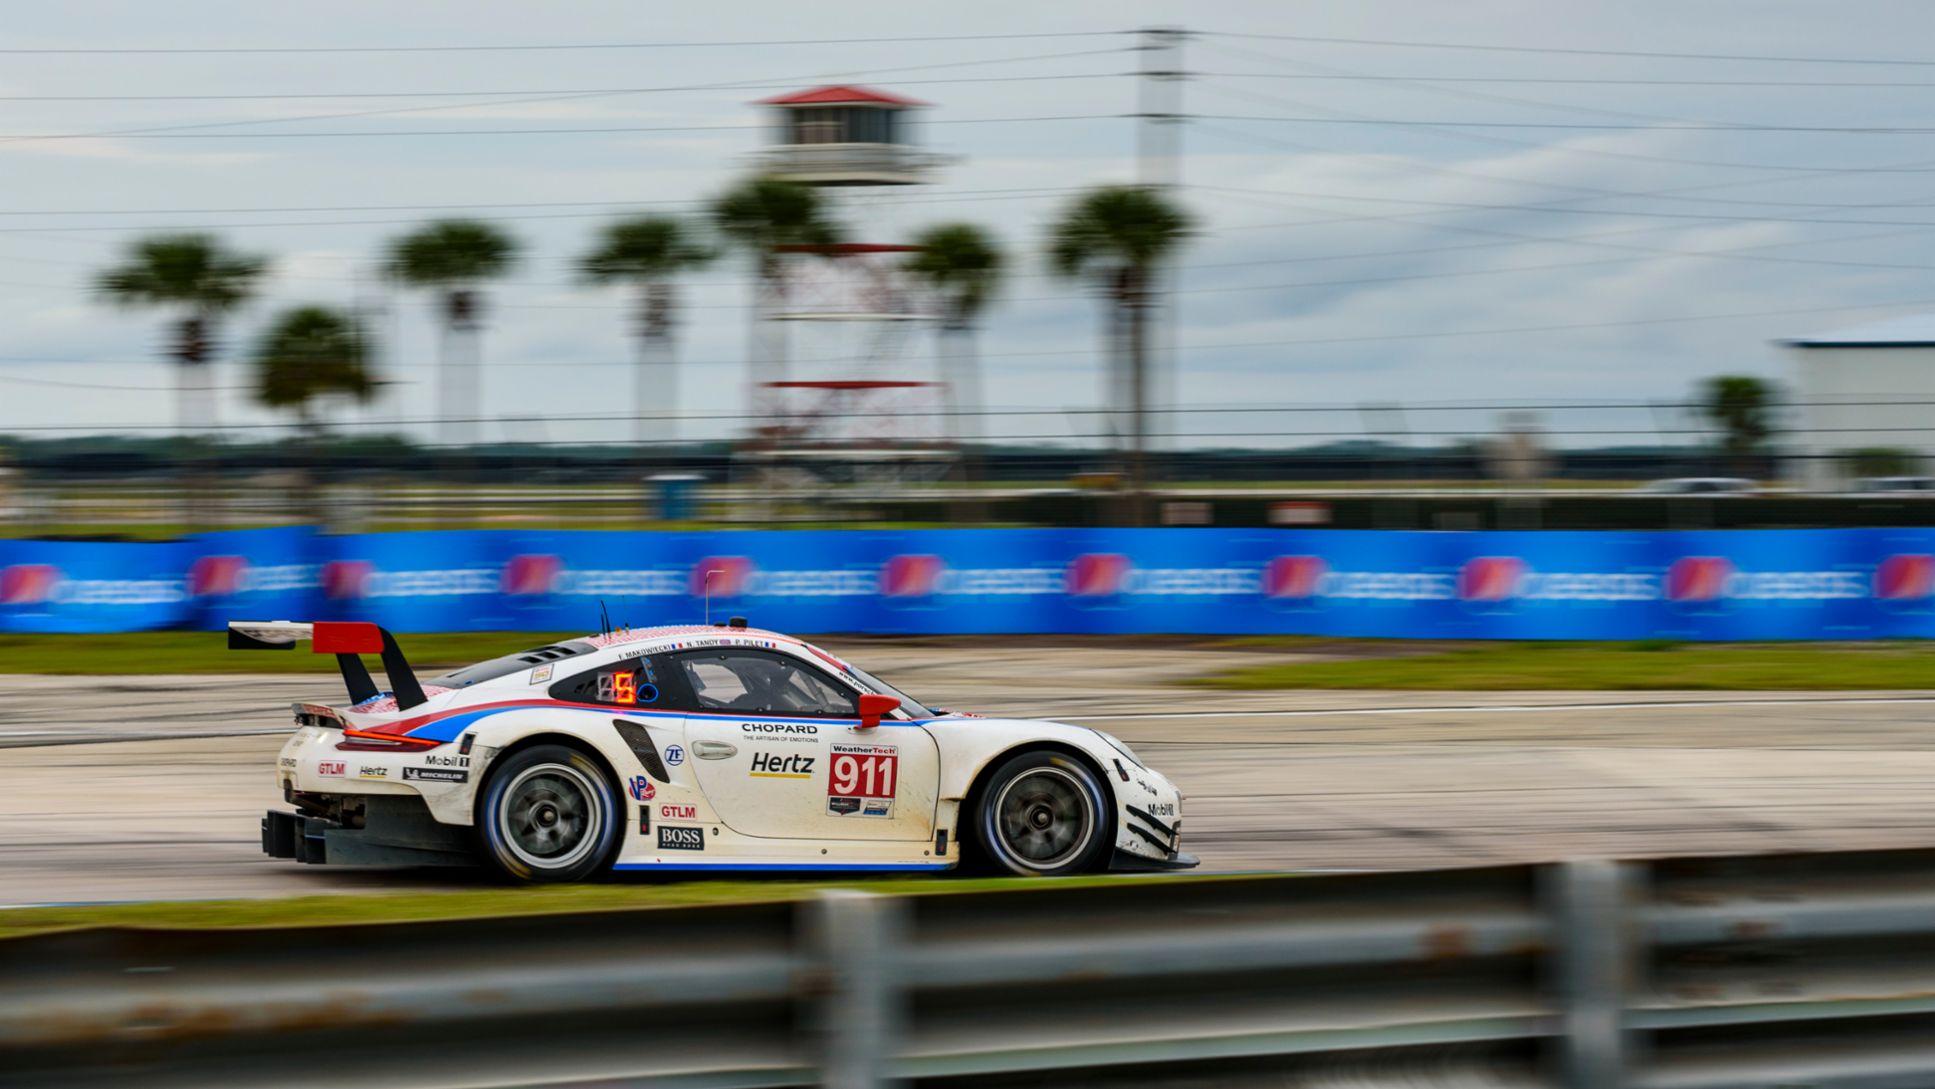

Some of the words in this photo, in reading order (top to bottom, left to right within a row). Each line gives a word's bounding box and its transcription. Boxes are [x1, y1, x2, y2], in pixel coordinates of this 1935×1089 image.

[625, 644, 671, 659] MAKOWIECKI
[741, 723, 818, 734] CHOPARD
[833, 745, 895, 754] WeatherTech
[425, 755, 457, 766] Mobil
[751, 752, 815, 773] Hertz
[319, 763, 345, 774] GTLM
[360, 766, 387, 776] Hertz
[834, 755, 892, 796] 911
[628, 775, 647, 800] VP
[661, 806, 696, 818] GTLM
[662, 828, 700, 843] BOSS
